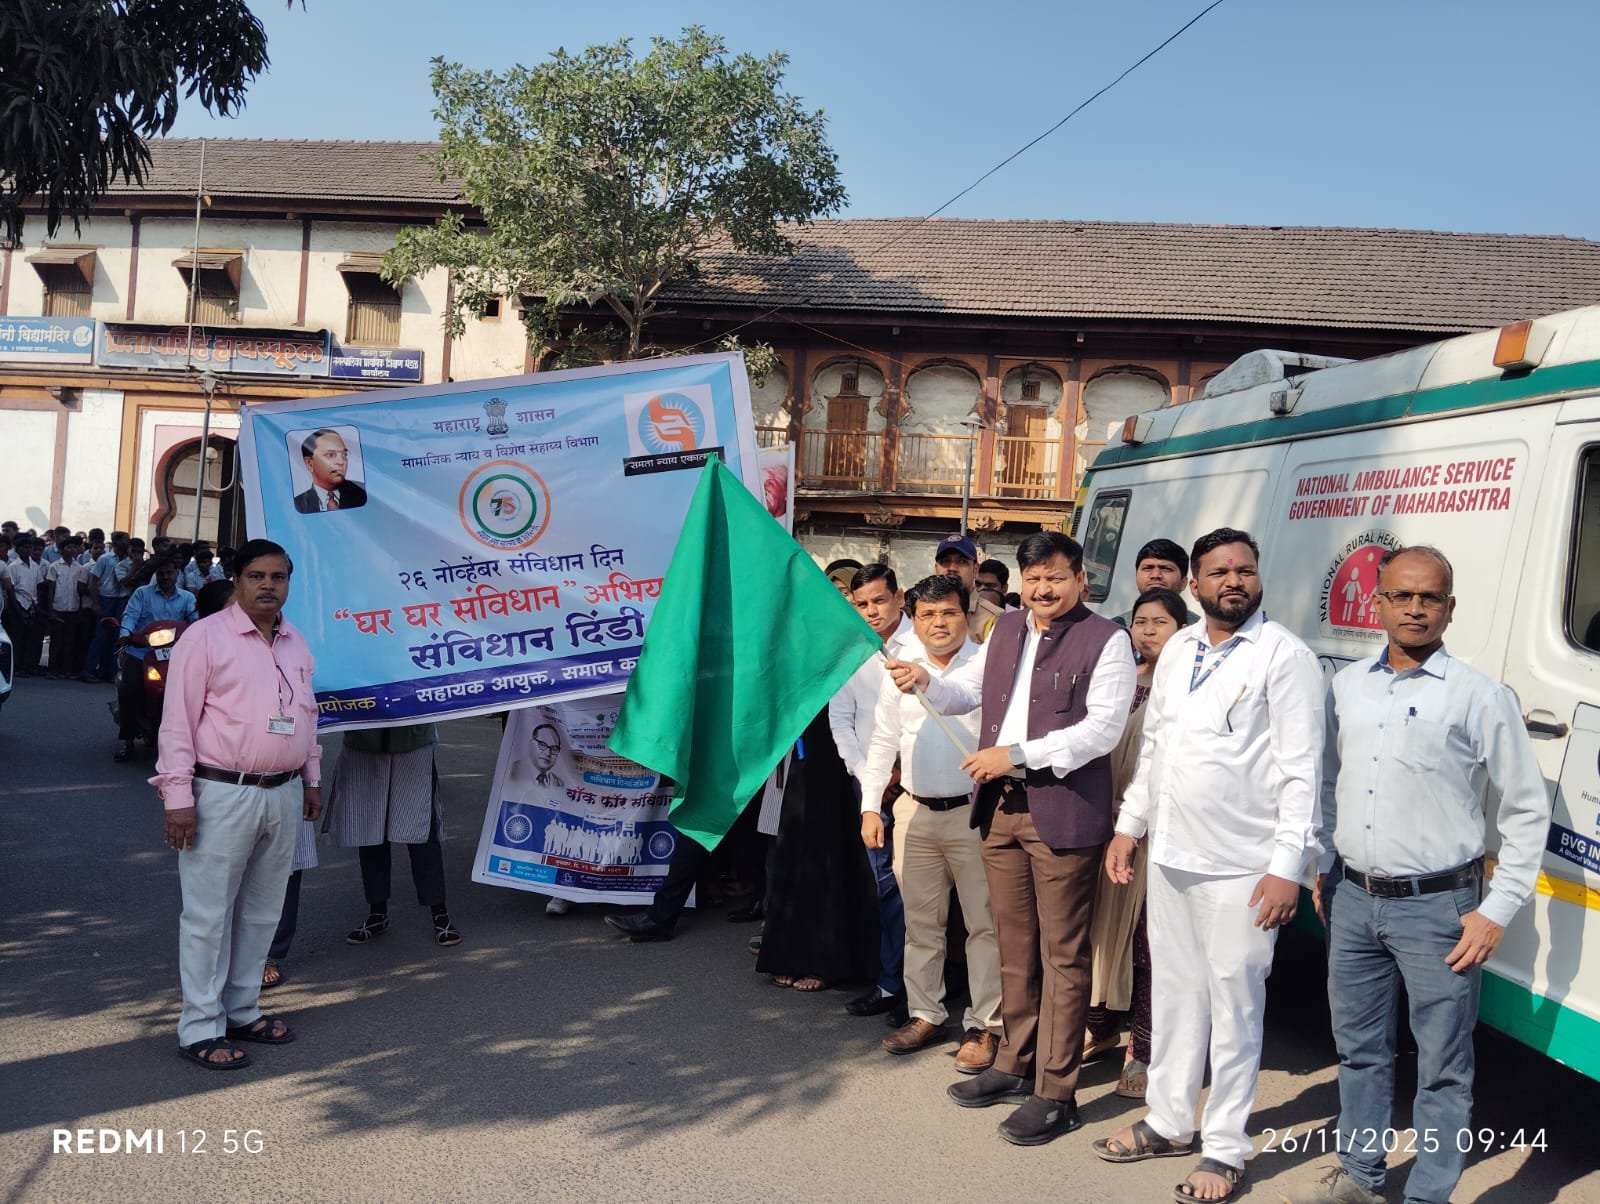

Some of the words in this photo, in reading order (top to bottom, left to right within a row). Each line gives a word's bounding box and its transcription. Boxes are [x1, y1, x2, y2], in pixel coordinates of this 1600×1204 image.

[105, 327, 211, 361] प्रतापसिंह
[213, 336, 324, 370] हायस्कूल
[433, 417, 481, 433] महाराष्ट्र
[515, 408, 556, 424] शासन
[401, 453, 452, 469] सामाजिक
[454, 450, 480, 462] न्याय
[484, 449, 493, 458] व
[496, 443, 526, 458] विशेष
[529, 443, 562, 454] सहाय्य
[566, 435, 600, 449] विभाग
[630, 460, 654, 469] समता
[657, 456, 678, 465] न्याय
[1296, 472, 1350, 497] NATIONAL
[1352, 464, 1442, 492] AMBULANCE
[1443, 457, 1516, 486] SERVICE
[1289, 495, 1370, 520] GOVERNMENT
[1371, 494, 1392, 516] OF
[1392, 487, 1511, 515] MAHARASHTRA
[399, 571, 426, 591] २६
[432, 555, 501, 585] नोव्हेंबर
[508, 552, 584, 575] संविधान
[590, 544, 624, 570] दिन
[1320, 553, 1345, 622] NATIONAL
[1346, 531, 1374, 554] RURAL
[401, 602, 442, 629] घर
[583, 571, 666, 604] अभिय
[408, 625, 555, 670] संविधान
[565, 605, 646, 649] दिंडी
[416, 681, 485, 703] सहायक
[491, 670, 556, 693] आयुक्त,
[562, 660, 613, 681] समाज
[566, 786, 597, 804] वॉक
[601, 793, 628, 809] फॉर
[1581, 790, 1600, 805] Hum
[1561, 832, 1587, 854] BVG
[1588, 844, 1600, 861] IN
[1565, 849, 1583, 862] Bharat
